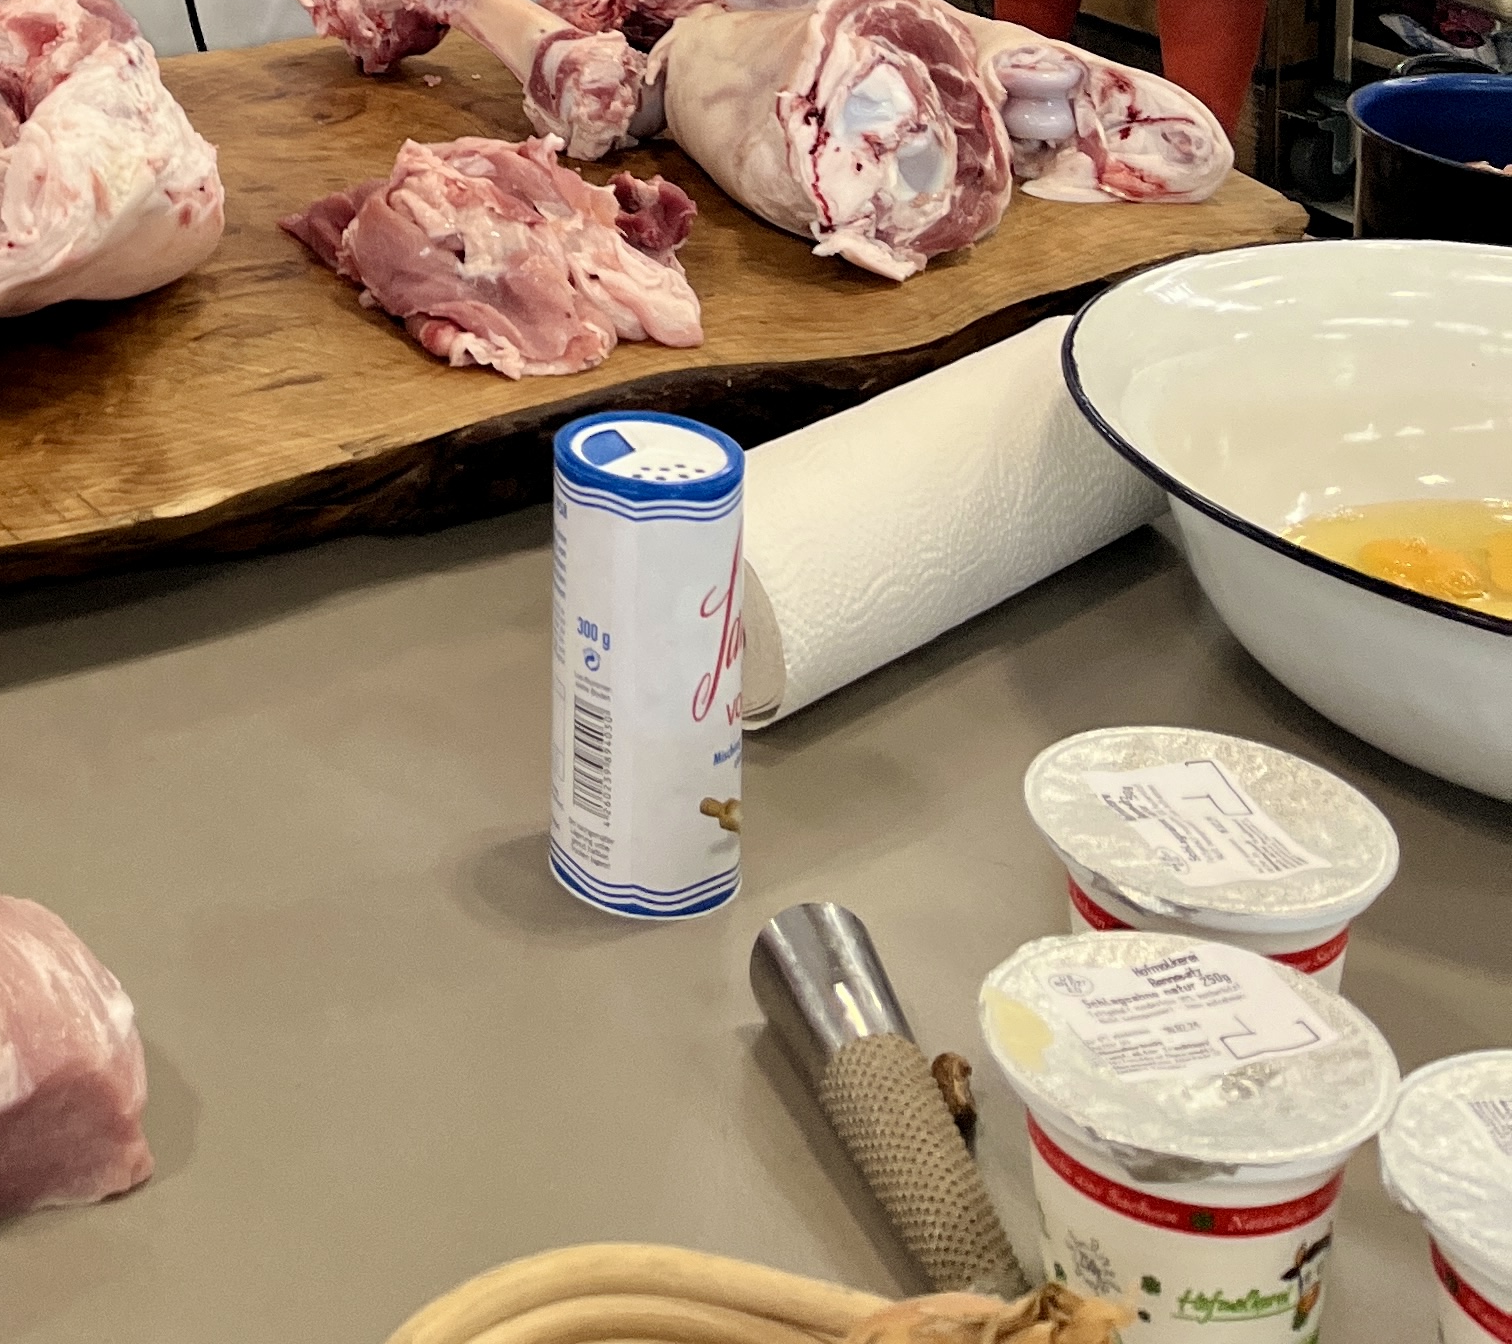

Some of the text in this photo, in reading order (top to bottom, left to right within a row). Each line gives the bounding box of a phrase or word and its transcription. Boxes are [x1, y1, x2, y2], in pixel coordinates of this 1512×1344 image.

[576, 616, 611, 652] 300 g
[1201, 972, 1232, 988] 250g
